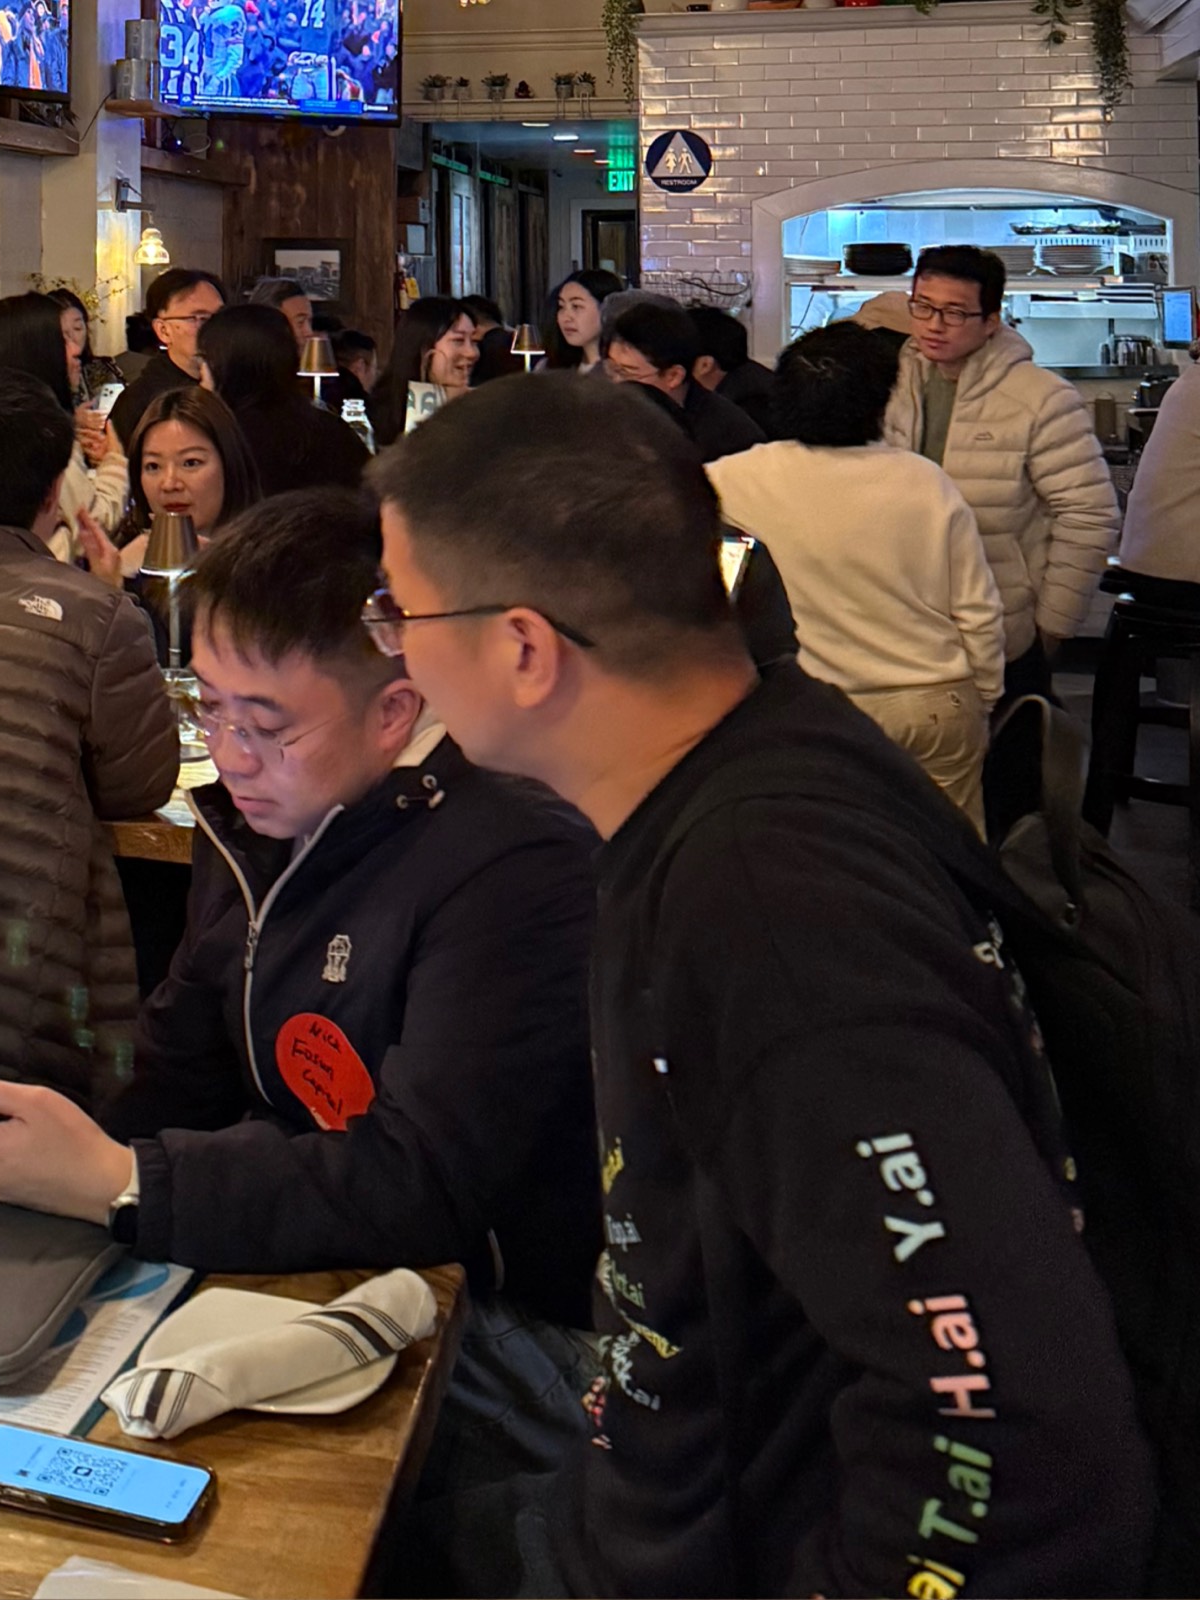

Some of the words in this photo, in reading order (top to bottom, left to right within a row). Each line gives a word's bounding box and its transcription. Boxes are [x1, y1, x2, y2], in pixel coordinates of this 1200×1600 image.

[608, 171, 635, 192] EXIT
[660, 179, 698, 187] RESTROOM
[907, 1295, 997, 1419] H.ai
[917, 1434, 994, 1545] T.ai
